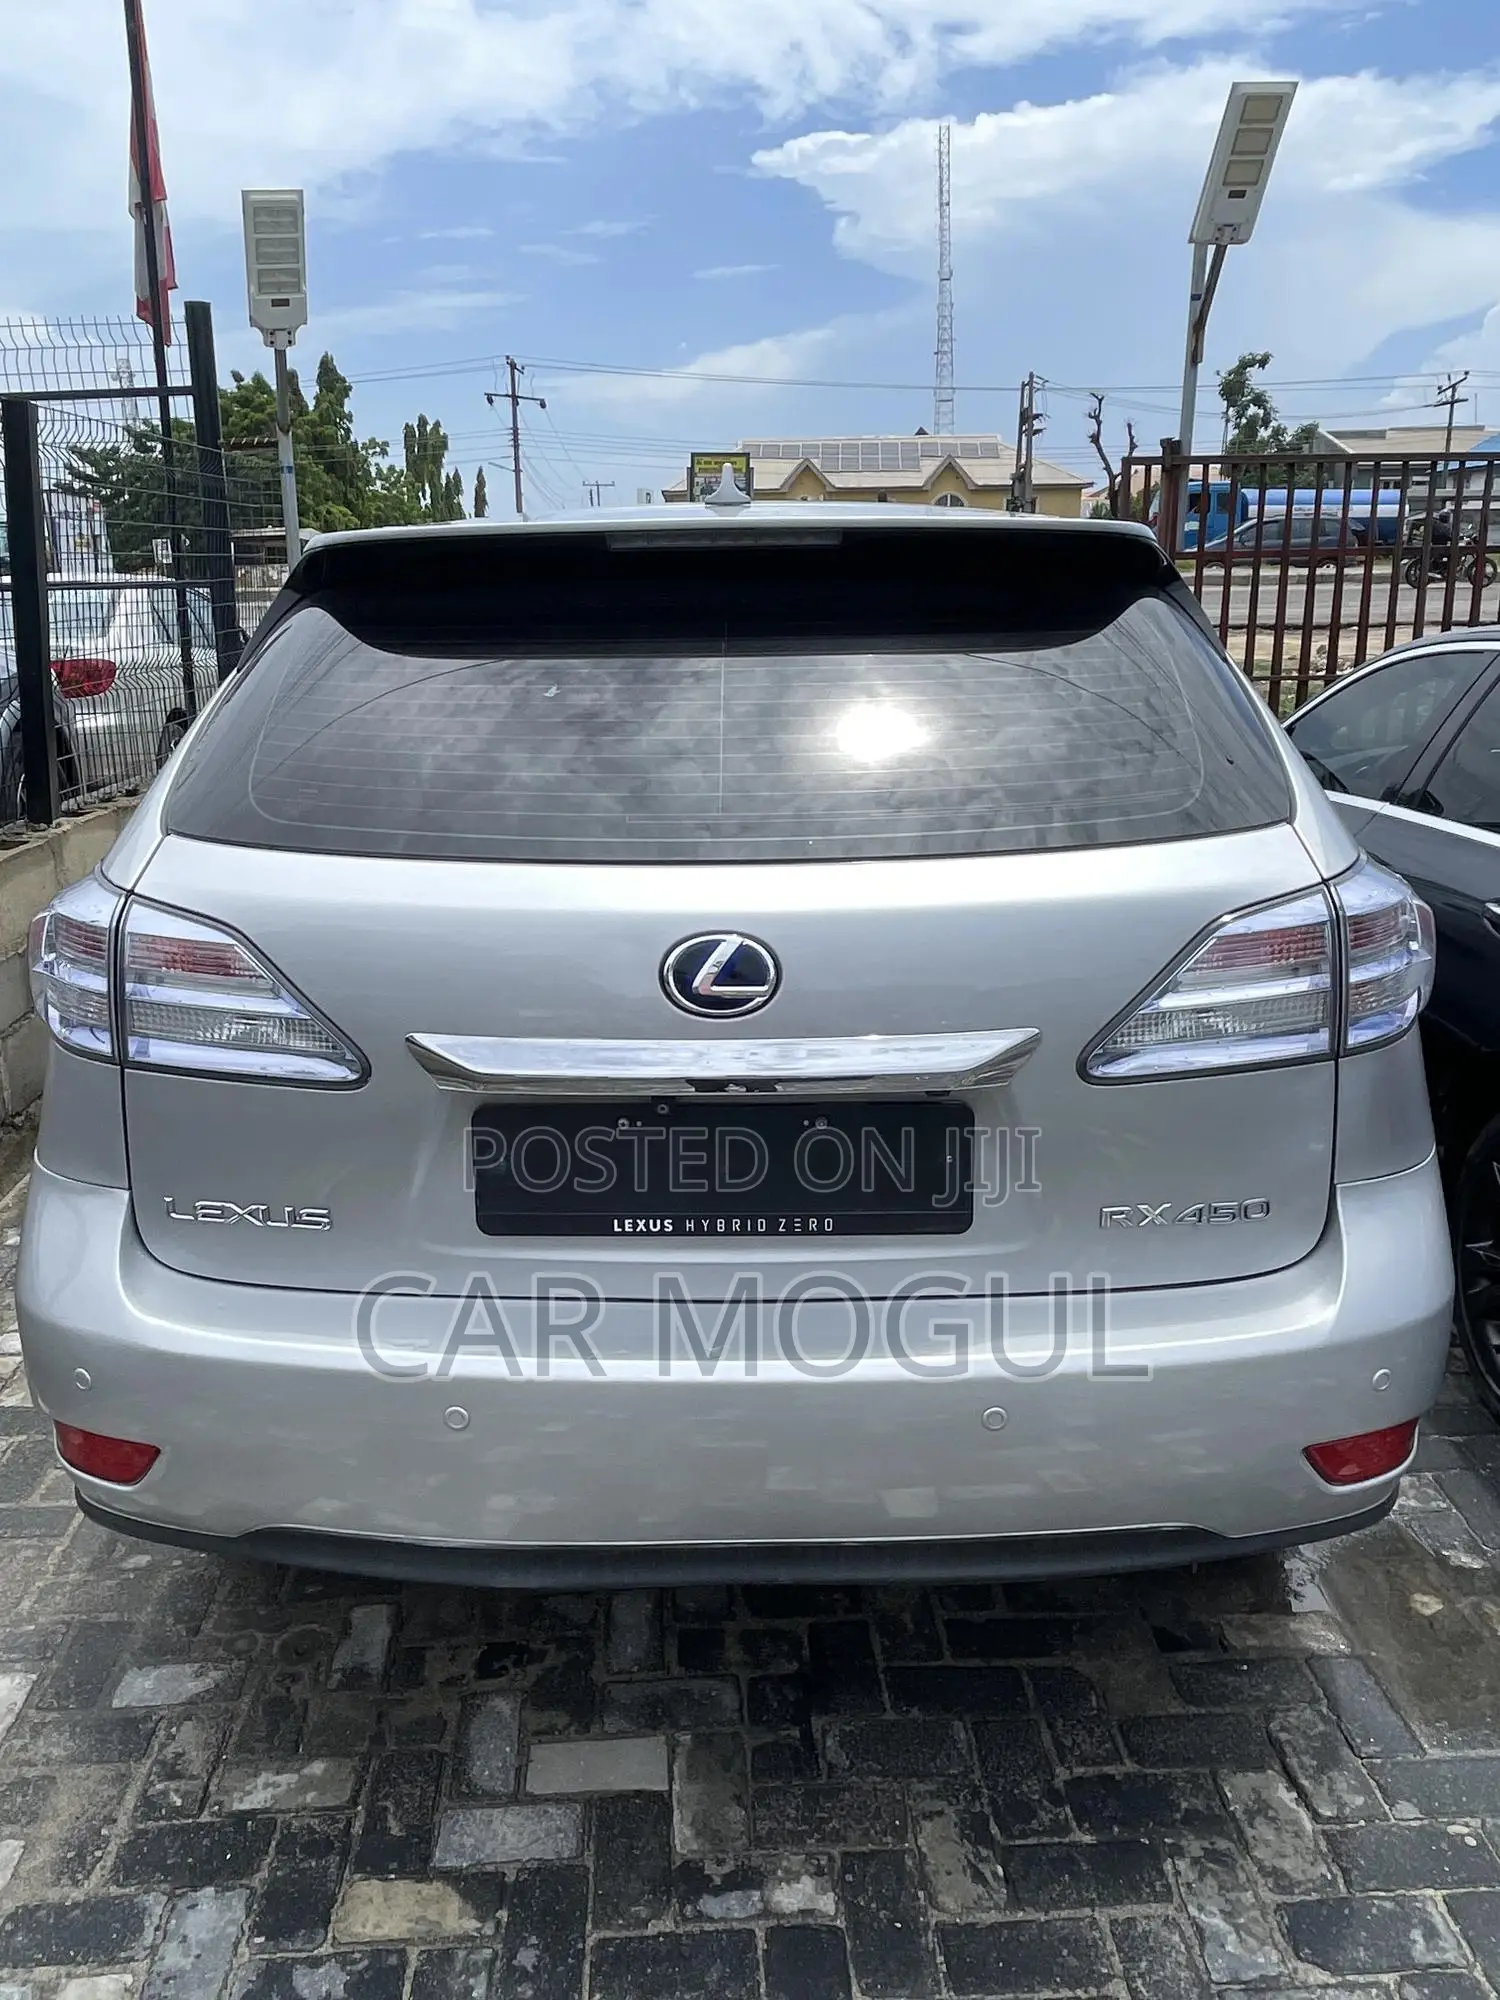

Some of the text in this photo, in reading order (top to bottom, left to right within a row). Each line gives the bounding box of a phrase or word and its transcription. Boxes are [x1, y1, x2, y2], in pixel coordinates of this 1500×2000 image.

[163, 1196, 332, 1231] LEXUS
[613, 1218, 834, 1232] LEXUS HYBRID ZERO
